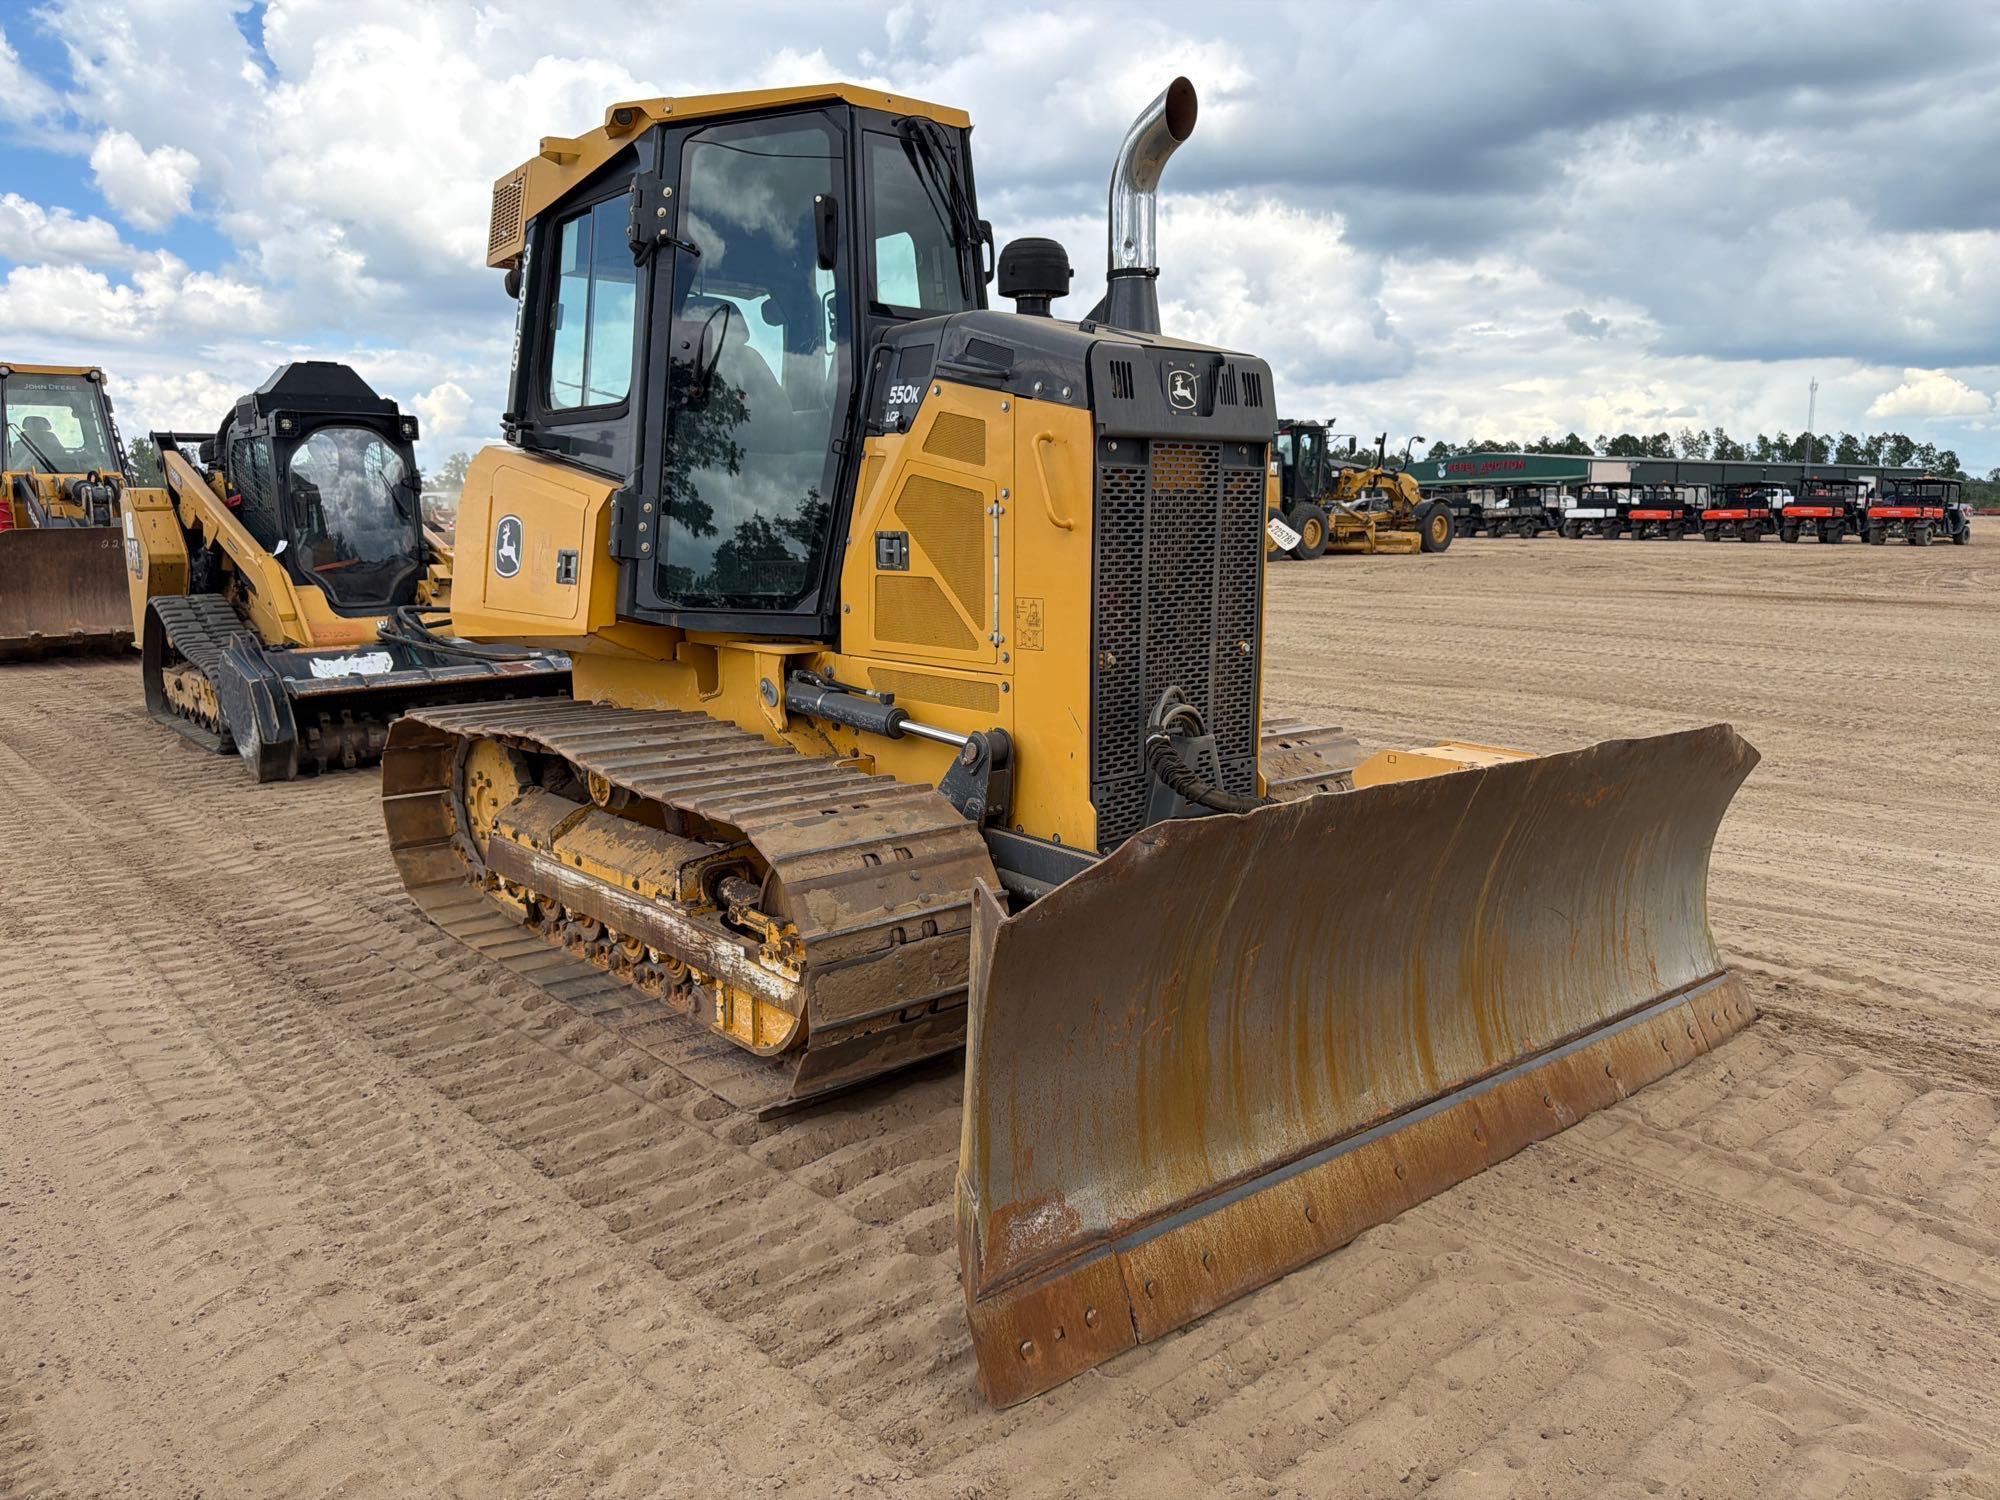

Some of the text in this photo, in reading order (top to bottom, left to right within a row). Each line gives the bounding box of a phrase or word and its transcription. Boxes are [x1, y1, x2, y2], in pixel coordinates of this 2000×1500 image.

[889, 385, 920, 404] 550K
[886, 411, 899, 422] LGP
[1270, 525, 1296, 545] 225786
